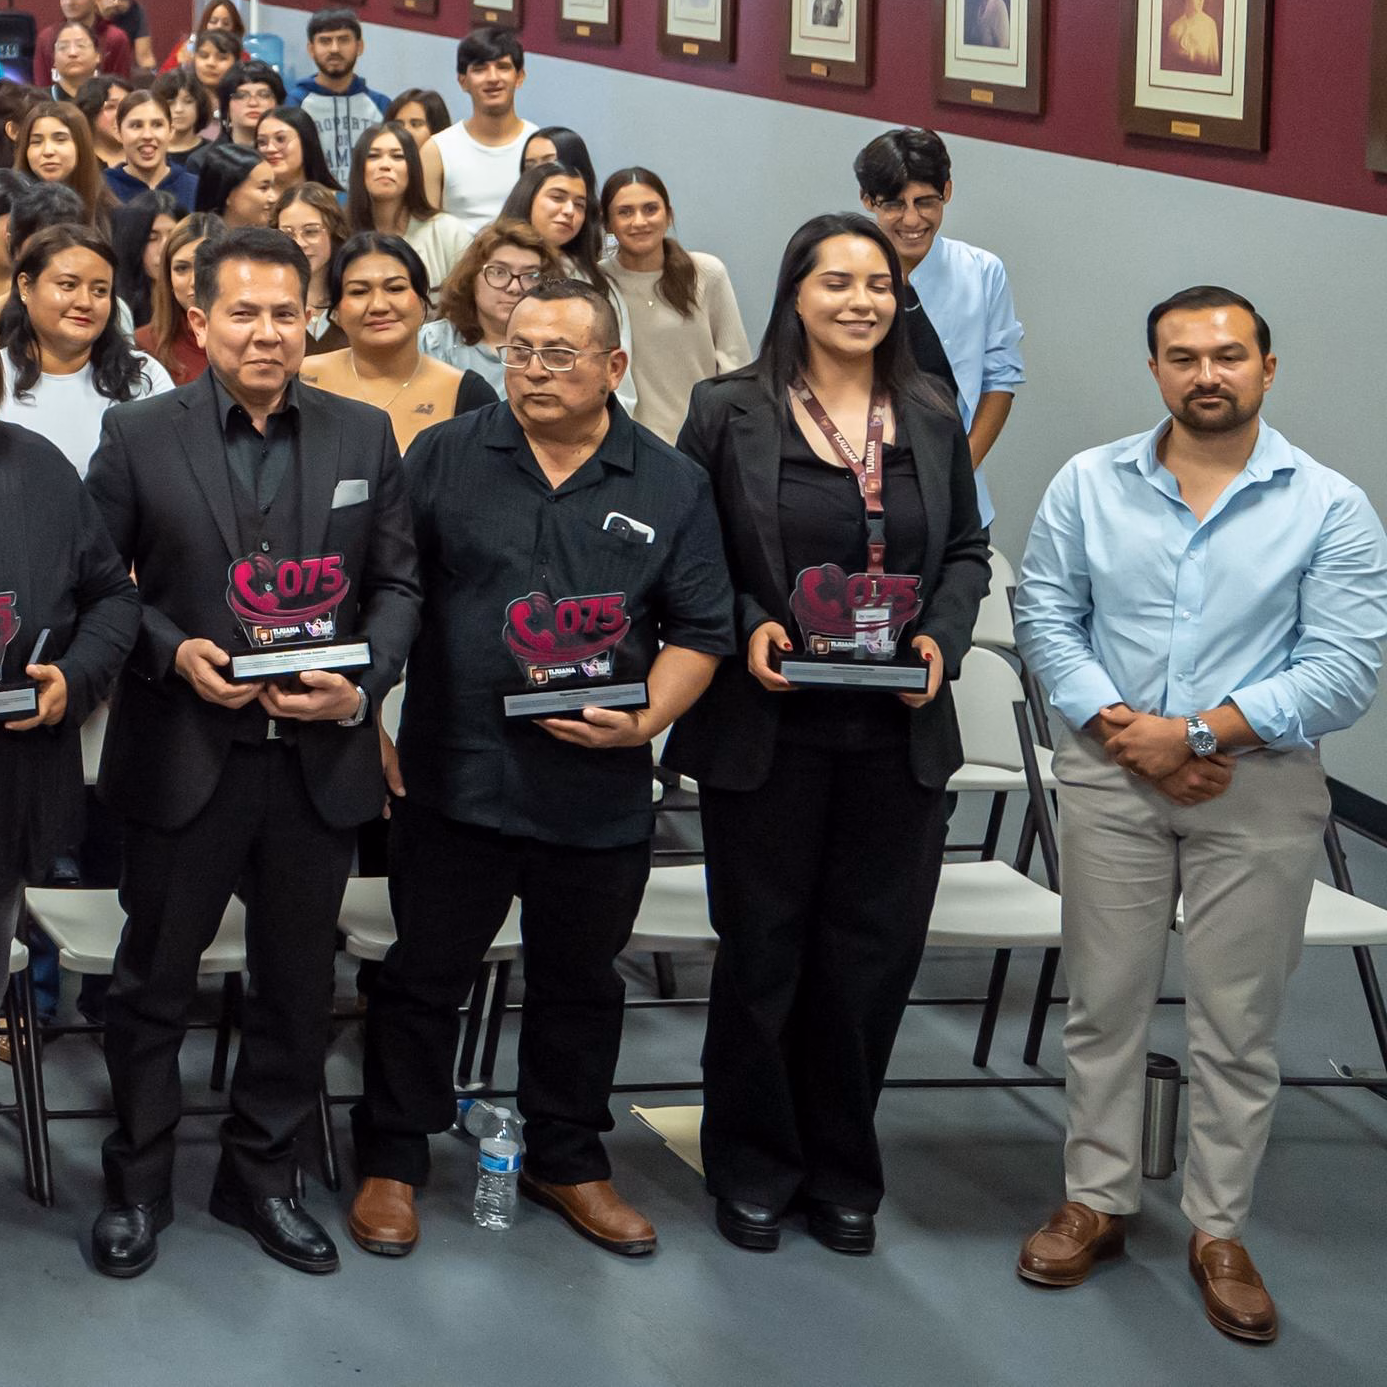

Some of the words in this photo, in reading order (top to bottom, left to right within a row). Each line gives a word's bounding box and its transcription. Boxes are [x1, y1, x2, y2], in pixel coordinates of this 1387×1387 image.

[833, 432, 859, 464] TIJUANA
[866, 440, 876, 473] TIJUANA
[278, 555, 344, 597] 075
[847, 576, 919, 610] 075
[555, 596, 624, 634] 075
